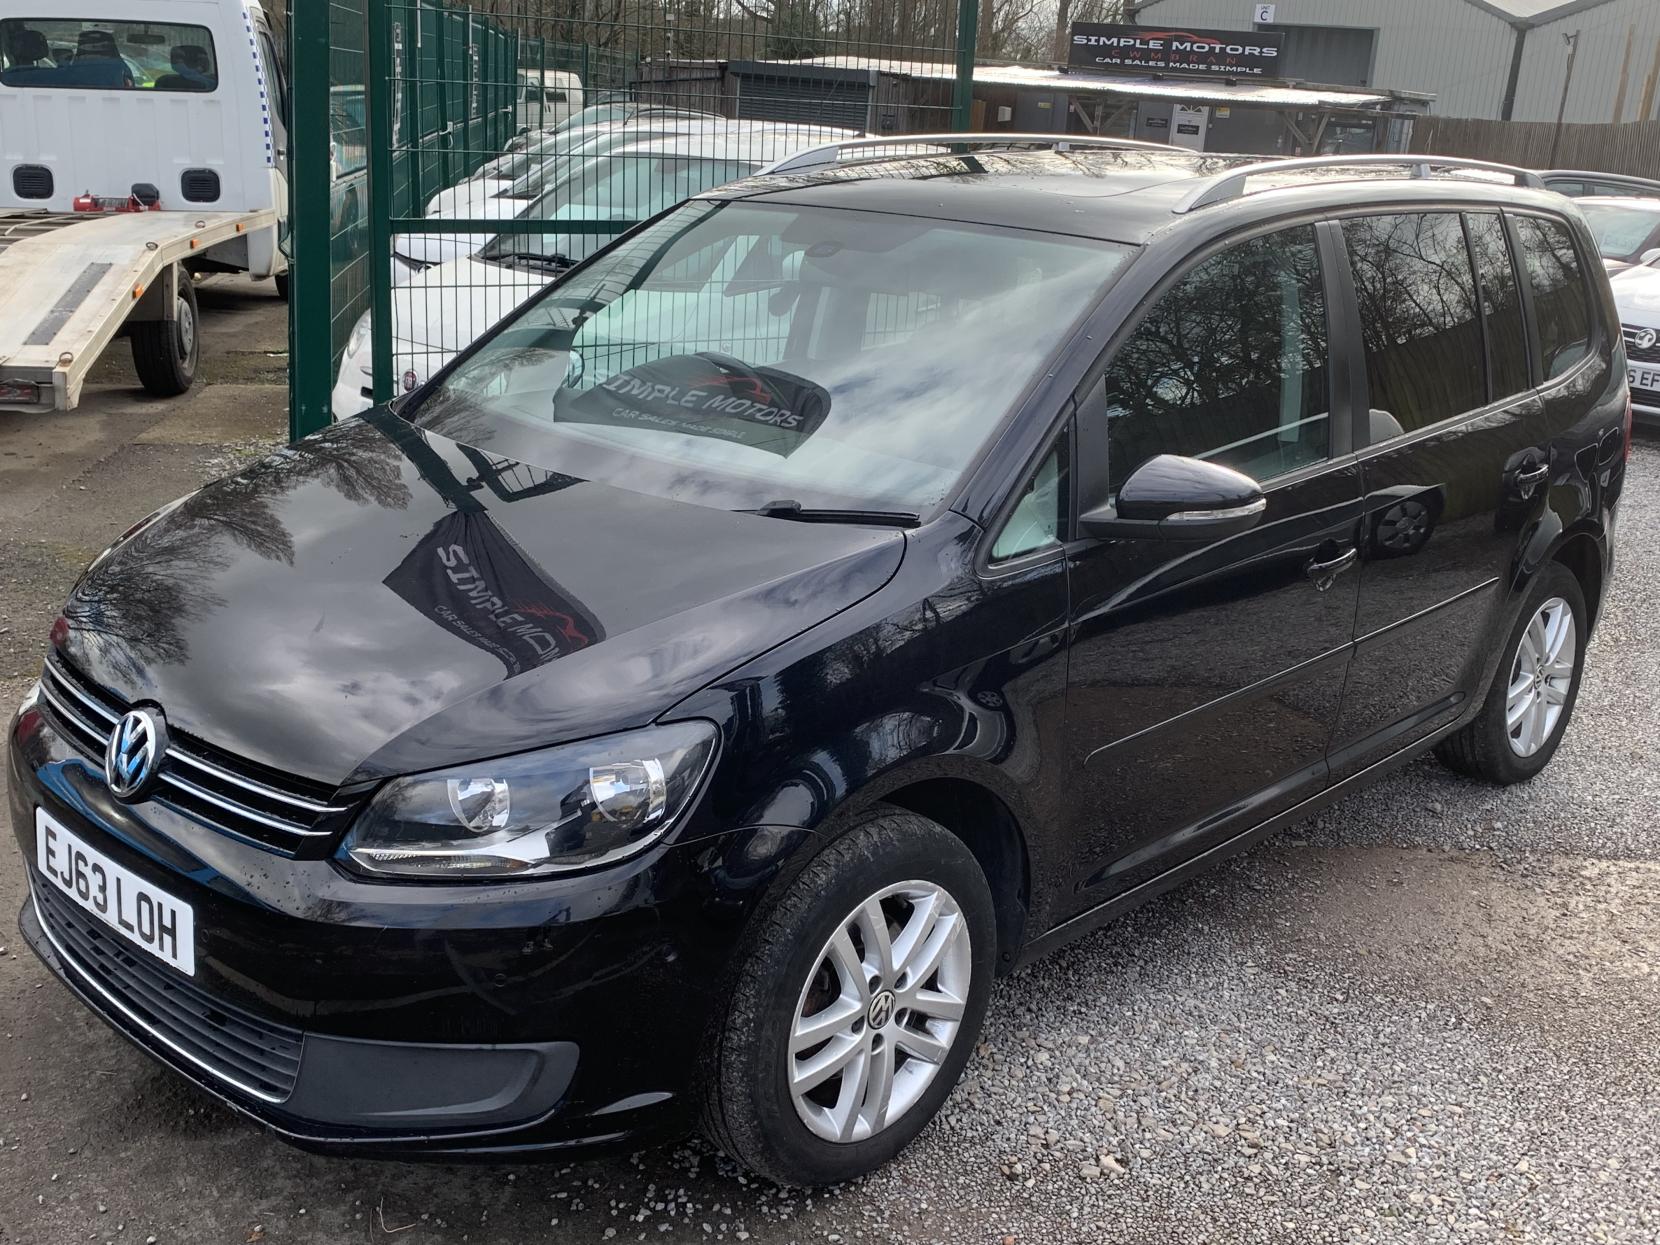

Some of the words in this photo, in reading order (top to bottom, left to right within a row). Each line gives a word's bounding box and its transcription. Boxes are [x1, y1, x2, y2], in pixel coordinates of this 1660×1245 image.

[1260, 10, 1269, 21] C
[1073, 35, 1164, 49] SIMPLE
[1171, 41, 1278, 57] MOTORS
[1124, 59, 1165, 67] SALES
[1169, 62, 1208, 70] MADE
[1210, 65, 1262, 74] SIMPLE
[612, 408, 640, 419] CAR
[702, 394, 804, 428] MOTORS
[45, 826, 108, 914] EJ63
[116, 876, 178, 960] LOH
